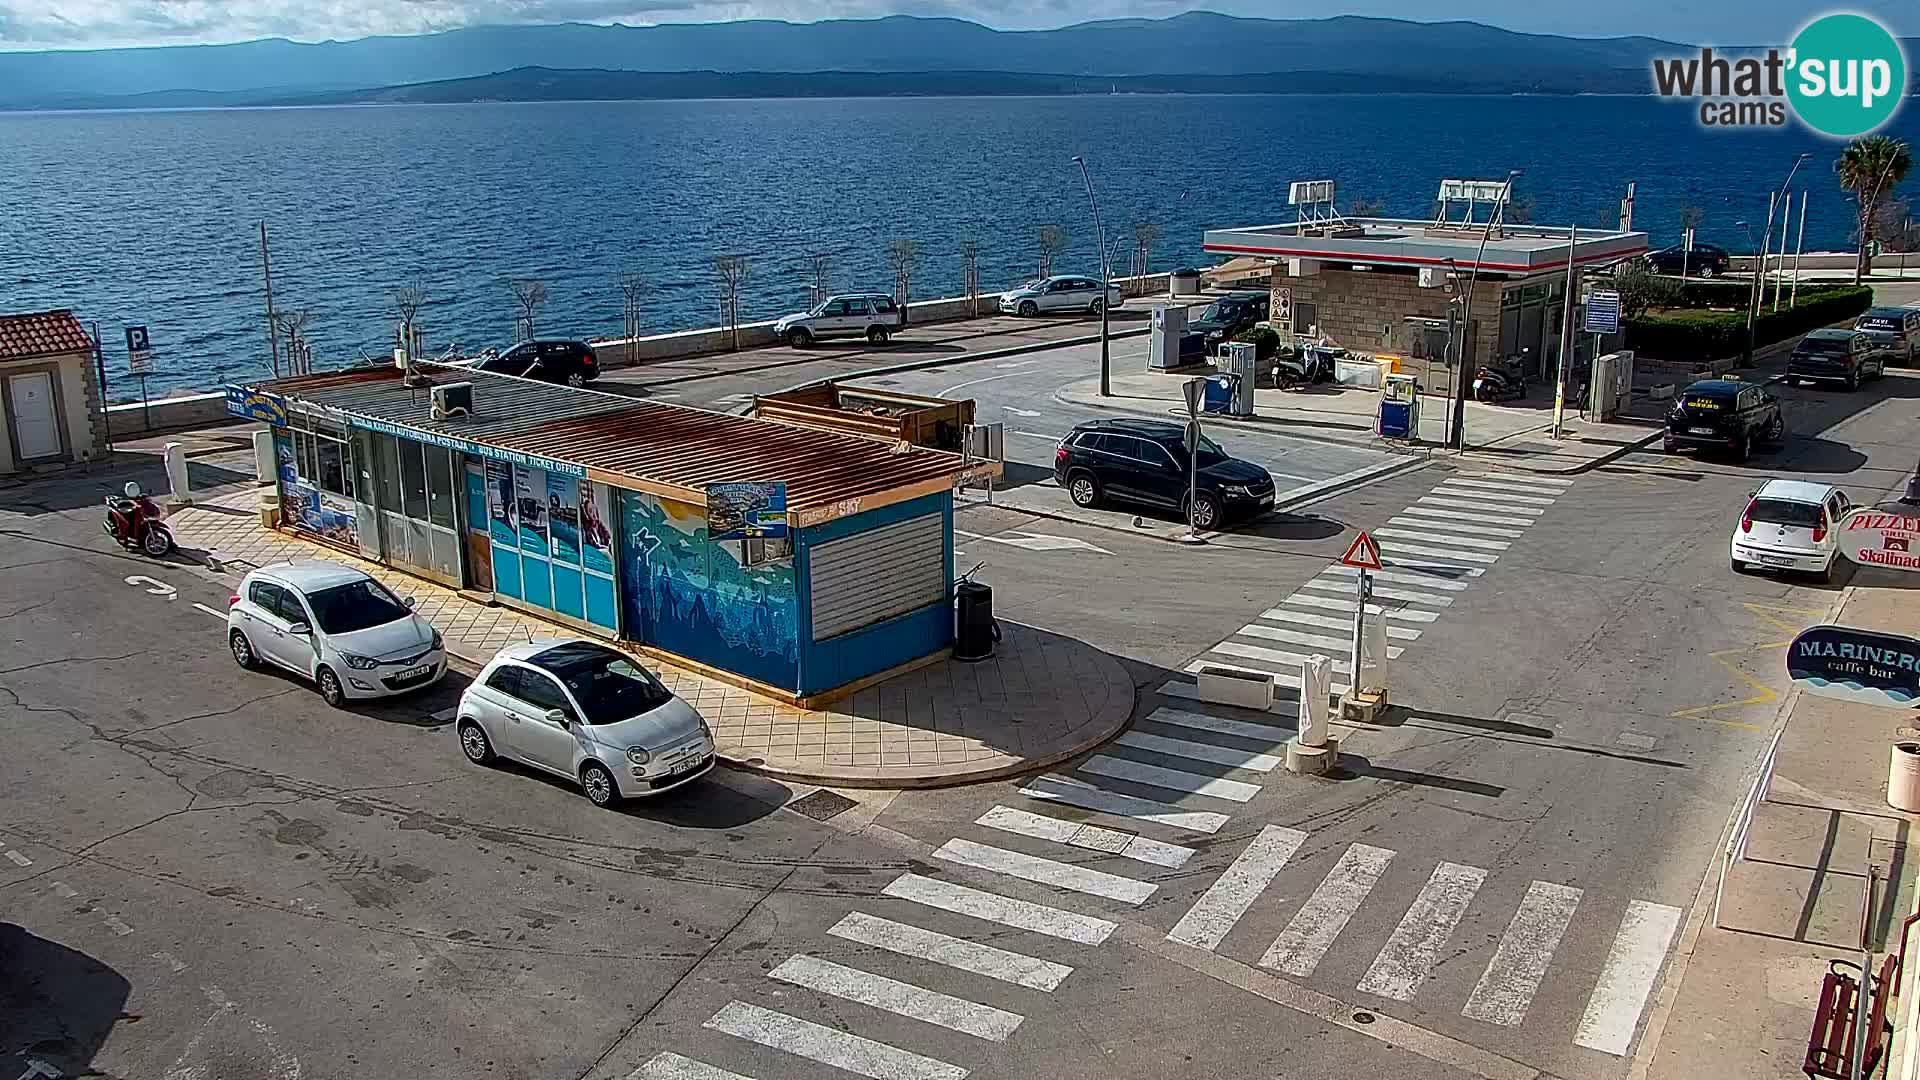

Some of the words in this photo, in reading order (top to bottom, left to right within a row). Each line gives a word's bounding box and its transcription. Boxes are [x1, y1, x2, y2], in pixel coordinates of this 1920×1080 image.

[396, 426, 437, 443] AUTOBUSNA
[437, 437, 469, 452] POSTAJA
[479, 445, 493, 457] BUS
[494, 449, 527, 464] STATION
[527, 455, 555, 470] TICKET
[555, 462, 583, 476] OFFICE
[1848, 515, 1920, 532] PIZZE
[1827, 661, 1864, 674] caffe
[1869, 665, 1896, 679] bar
